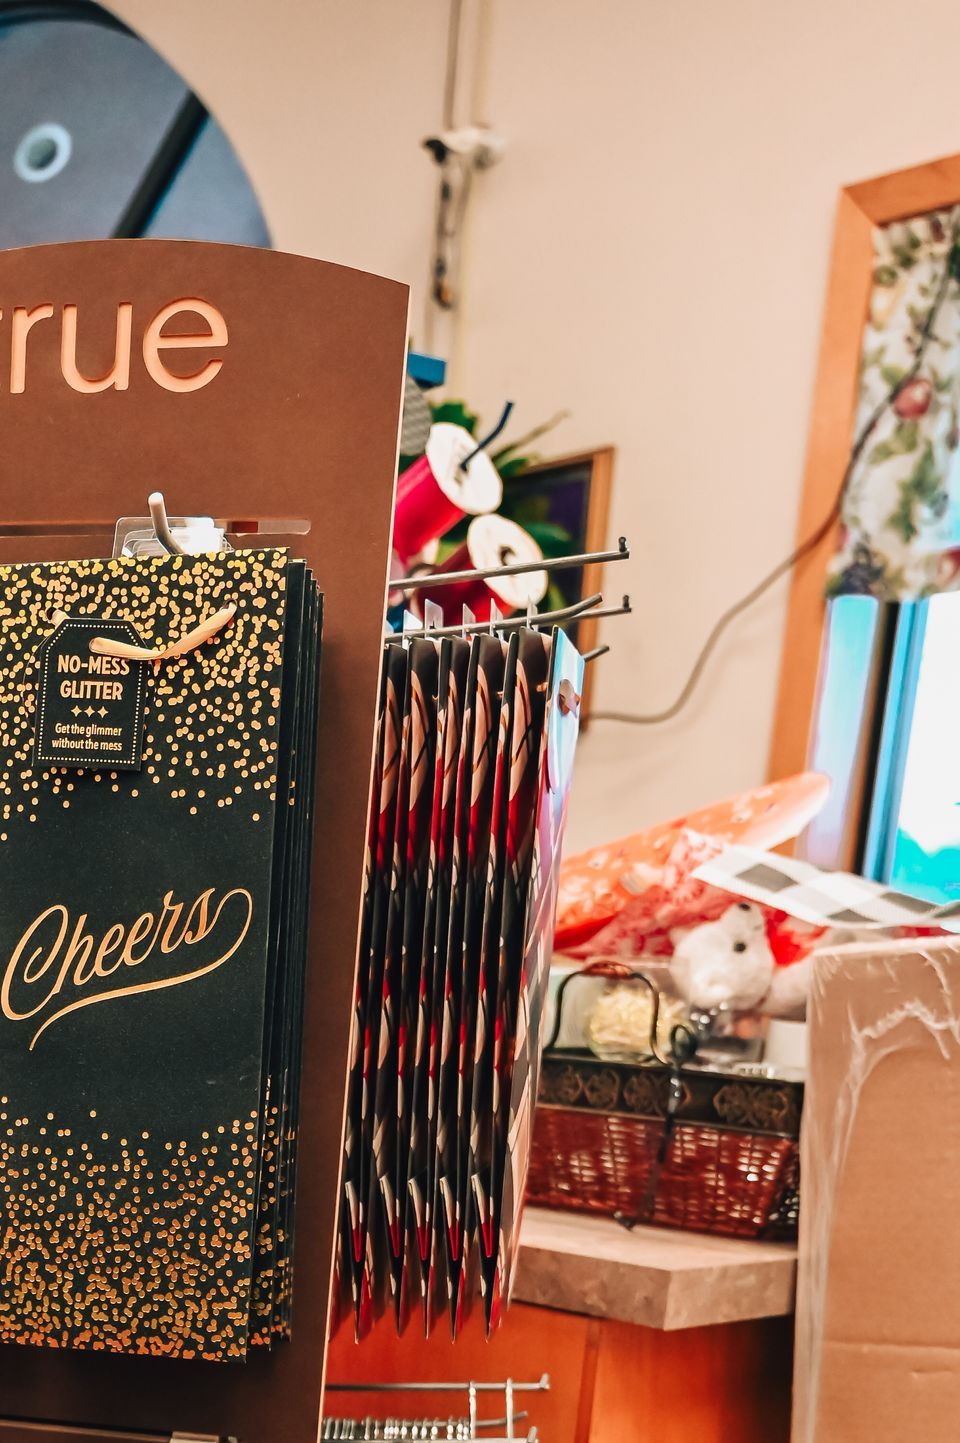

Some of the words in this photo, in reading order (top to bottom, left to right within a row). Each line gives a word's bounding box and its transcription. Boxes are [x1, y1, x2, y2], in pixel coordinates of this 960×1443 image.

[57, 654, 130, 675] NO-MESS
[60, 680, 123, 700] GLITTER
[55, 722, 70, 734] Get
[71, 723, 85, 734] the
[86, 724, 122, 737] glimmer
[52, 738, 84, 749] without
[84, 739, 99, 750] the
[100, 741, 122, 751] mess
[1, 887, 253, 1051] Cheers
